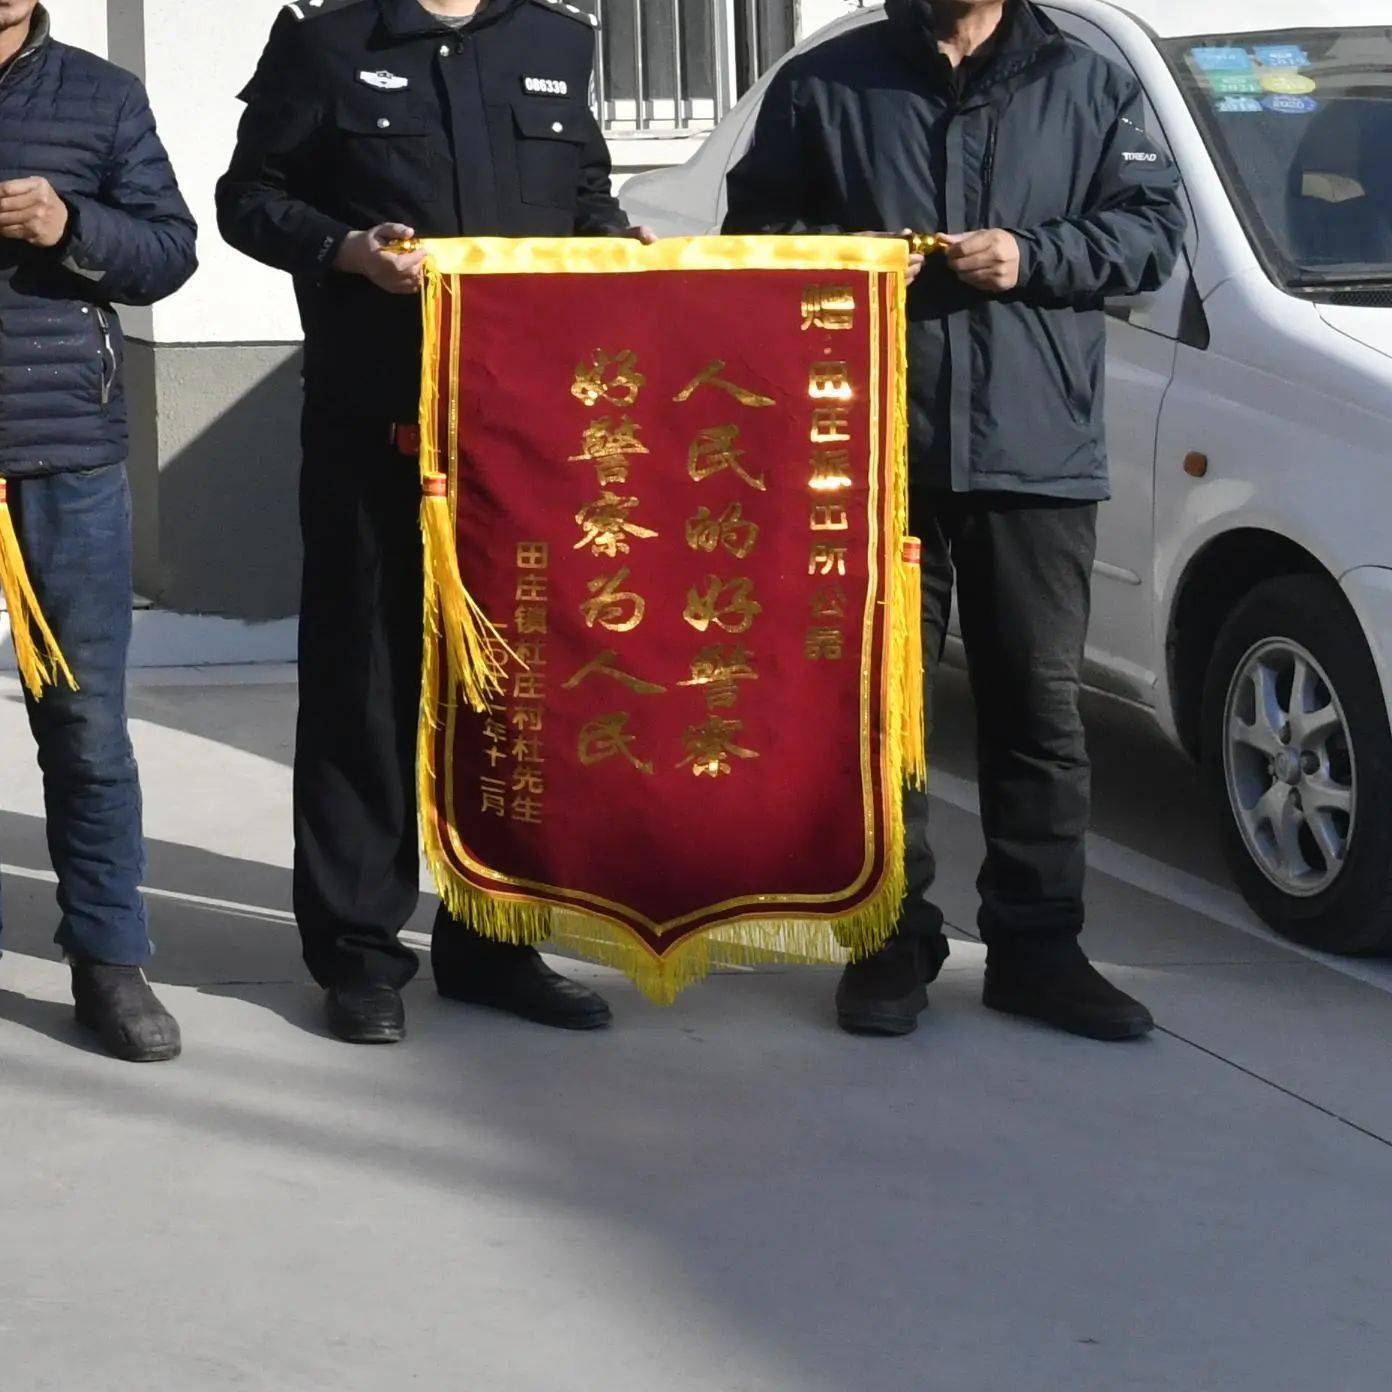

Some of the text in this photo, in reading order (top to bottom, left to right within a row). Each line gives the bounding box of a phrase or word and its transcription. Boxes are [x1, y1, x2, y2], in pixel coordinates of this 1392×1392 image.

[560, 346, 667, 776] 好警察为人民
[672, 358, 777, 779] 人民的好警察
